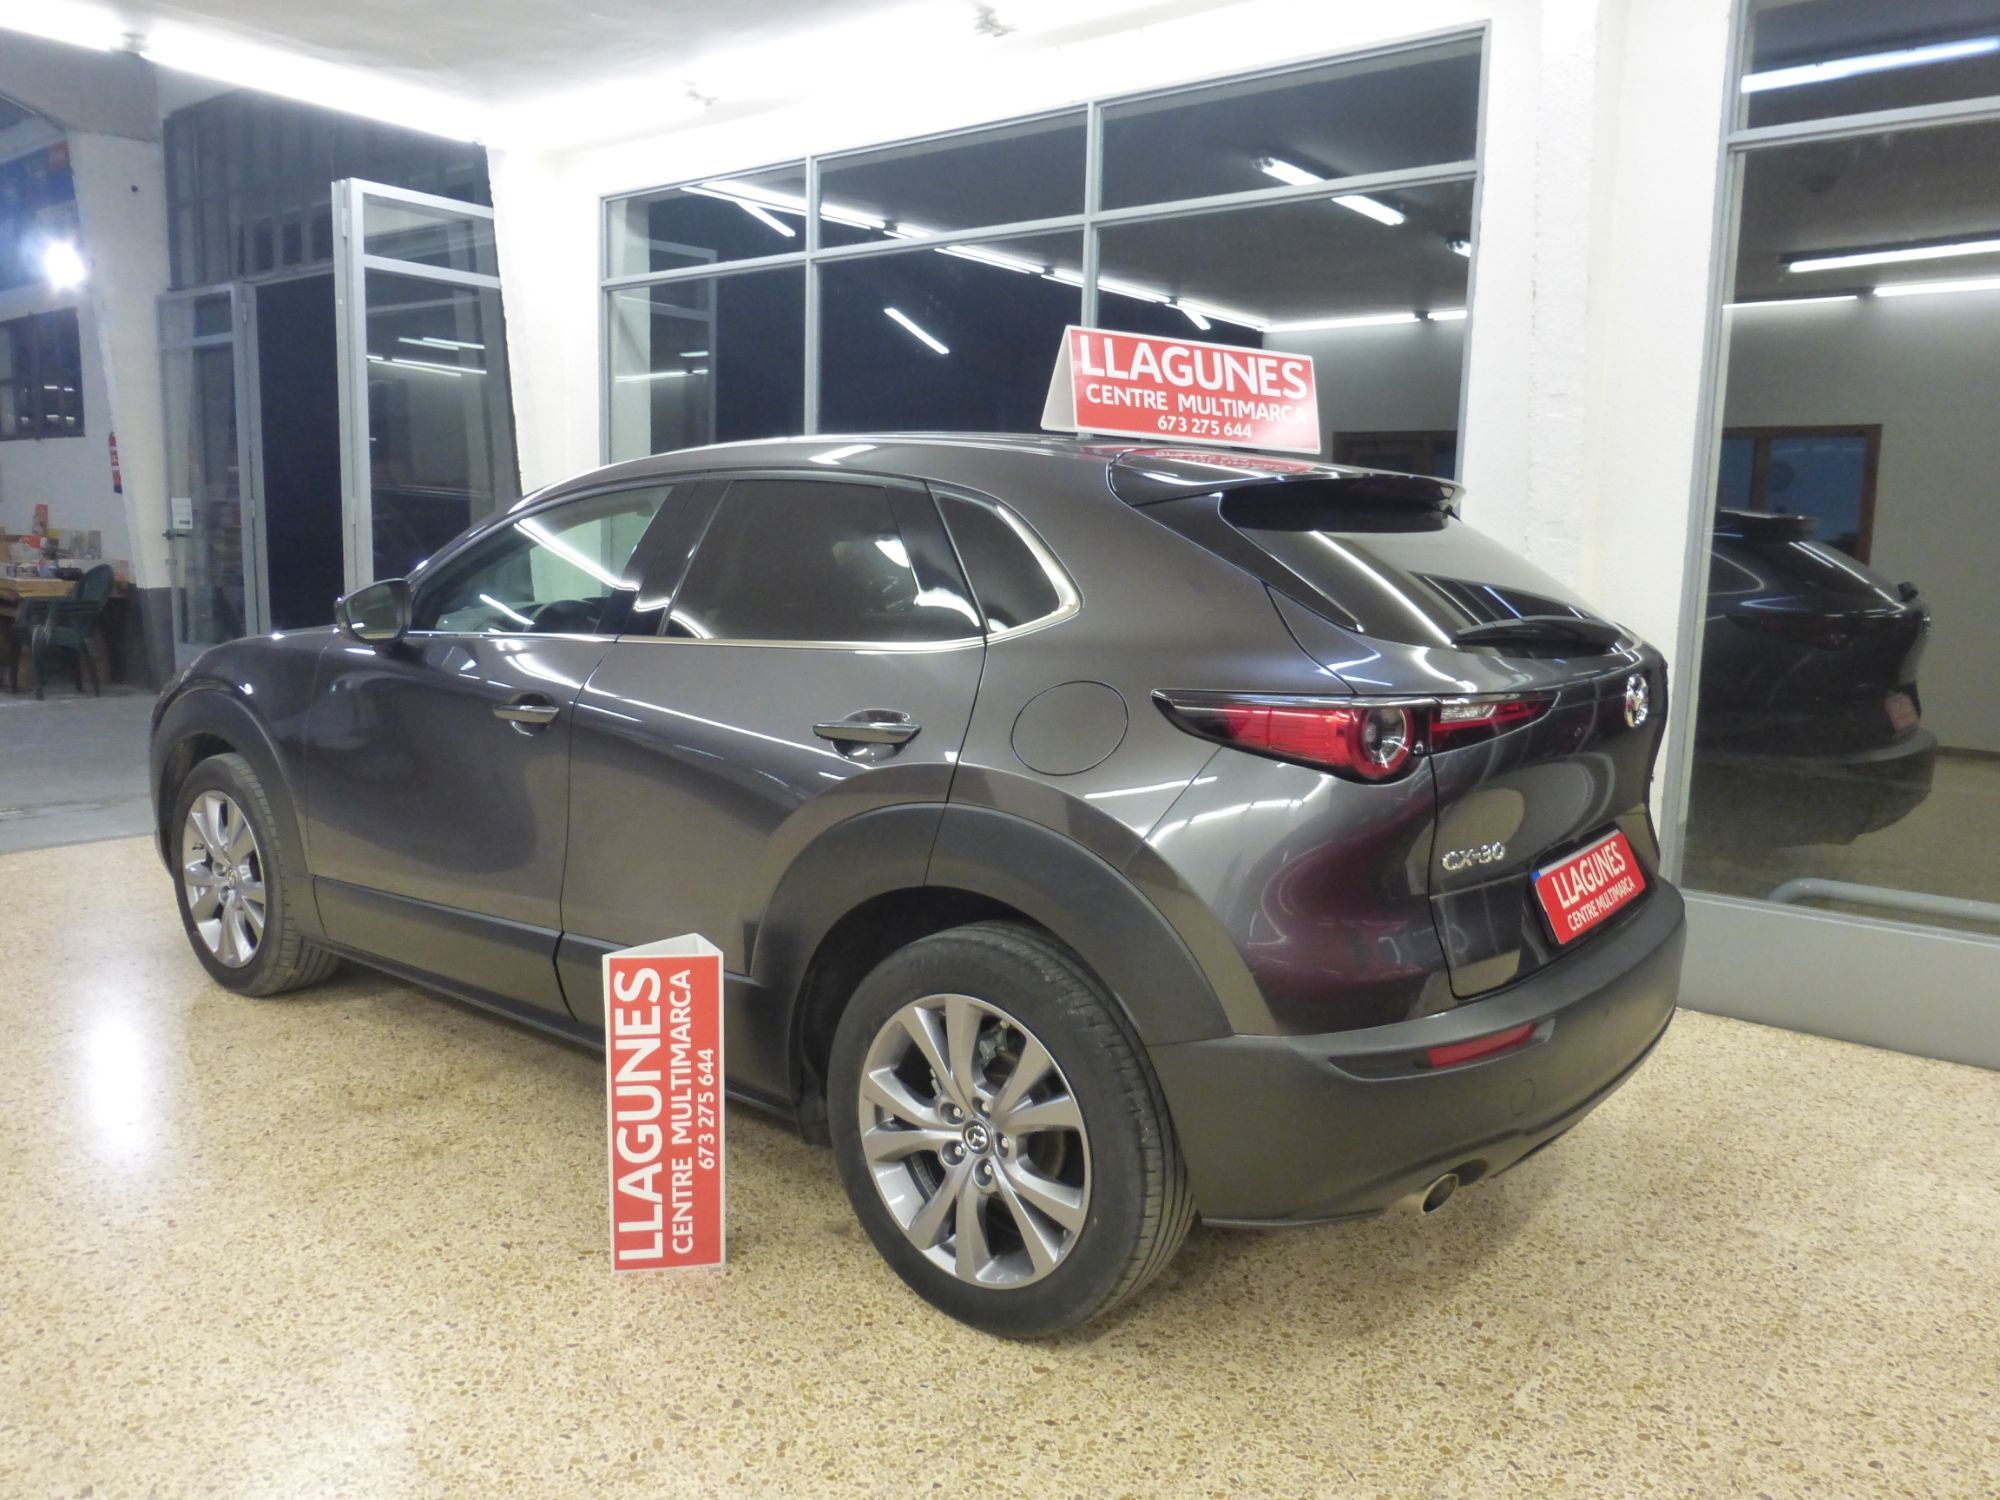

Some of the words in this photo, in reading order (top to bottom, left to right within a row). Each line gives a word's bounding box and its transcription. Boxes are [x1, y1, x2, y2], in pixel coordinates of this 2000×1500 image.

[1079, 335, 1307, 400] LLAGUNES
[1086, 384, 1168, 411] CENTRE
[1178, 393, 1308, 425] MULTIMARCA
[1157, 415, 1188, 432] 673
[1191, 418, 1220, 434] 275
[1223, 422, 1252, 438] 644
[1441, 841, 1505, 870] CX-30
[1552, 840, 1626, 909] LLAGUNES
[1567, 901, 1598, 932] CENTRE
[1595, 876, 1636, 915] MULTIMARCA
[669, 969, 692, 1144] MULTIMARCA
[697, 1048, 714, 1085] 644
[614, 967, 663, 1260] LLAGUNES
[698, 1091, 714, 1129] 275
[698, 1133, 715, 1170] 673
[671, 1157, 693, 1254] CENTRE
